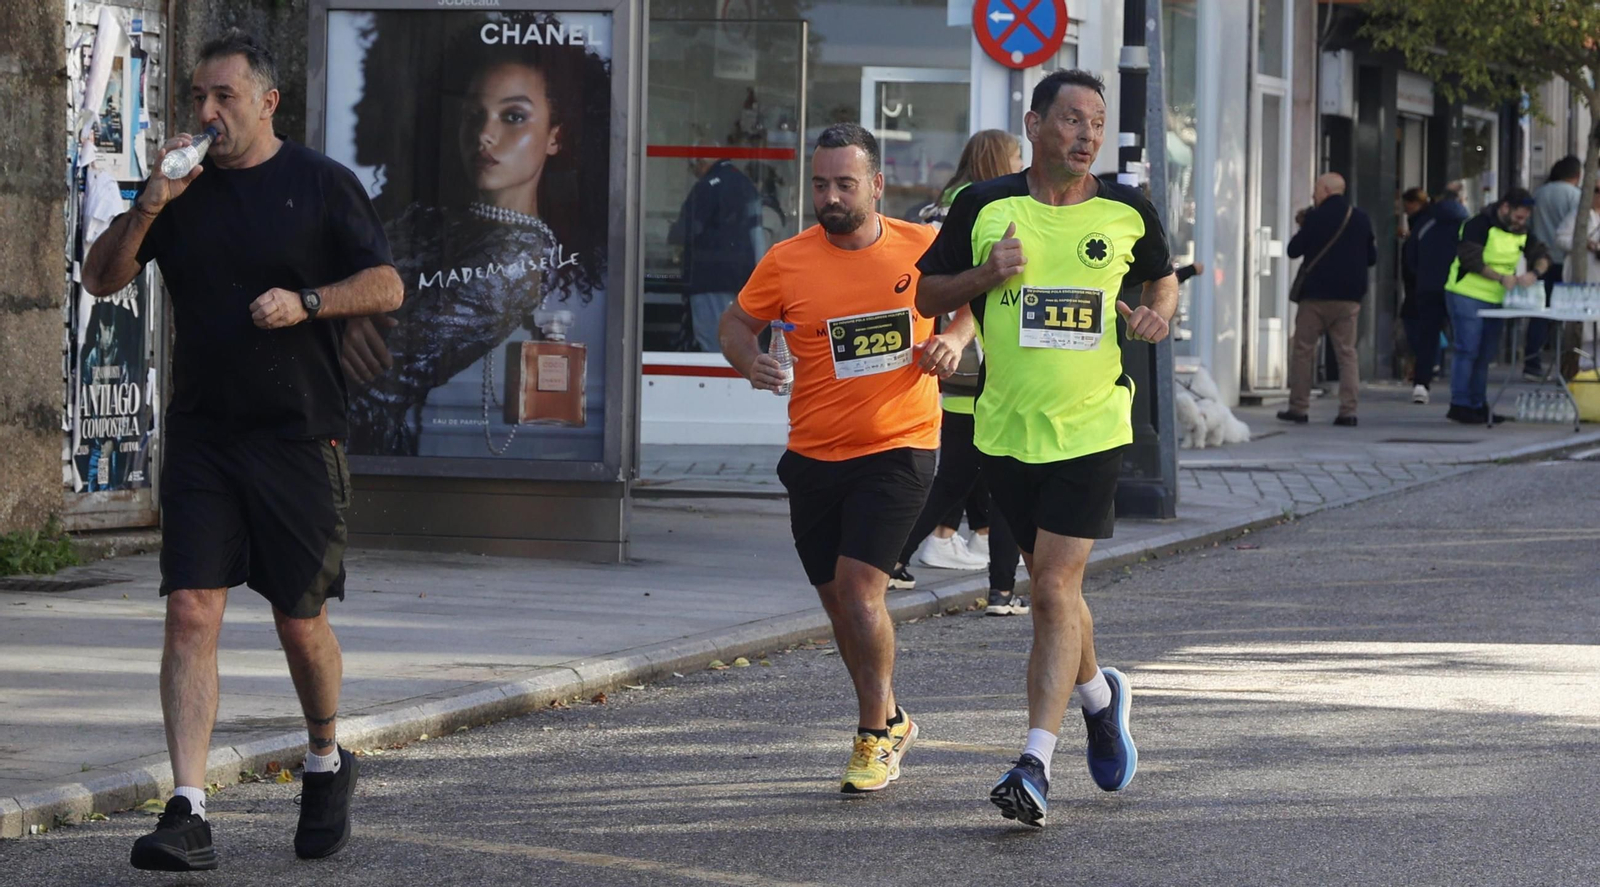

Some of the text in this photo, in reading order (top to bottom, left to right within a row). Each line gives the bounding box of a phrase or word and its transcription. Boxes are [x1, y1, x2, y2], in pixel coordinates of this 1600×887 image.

[480, 23, 602, 45] CHANEL
[418, 244, 579, 290] MADEMOISELLE
[1044, 306, 1093, 329] 115
[853, 330, 902, 357] 229
[80, 383, 141, 416] ANTIAGO
[82, 416, 140, 439] COMPOSTELA
